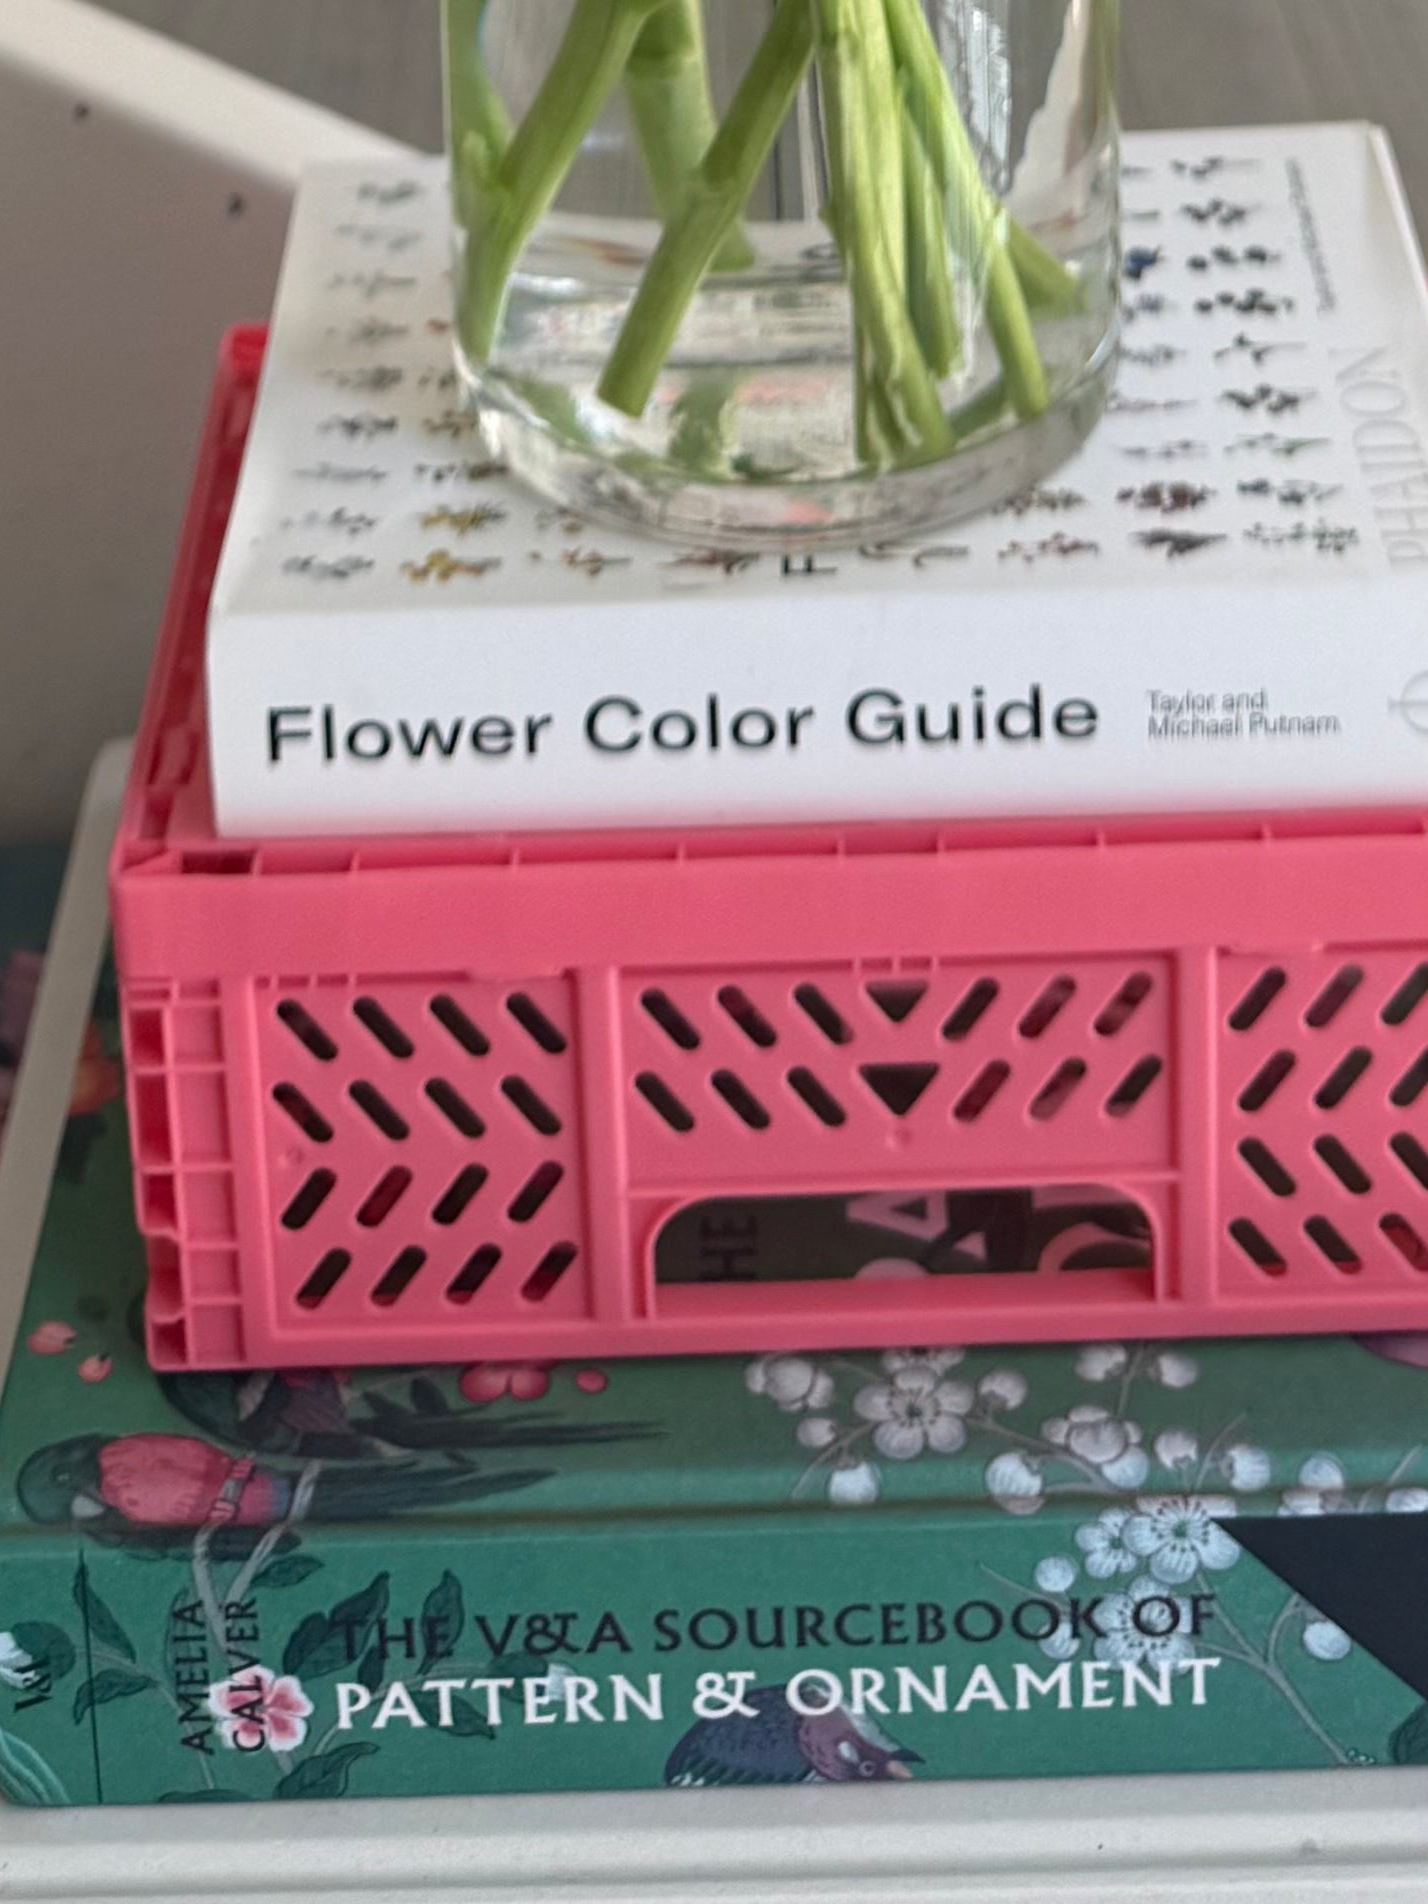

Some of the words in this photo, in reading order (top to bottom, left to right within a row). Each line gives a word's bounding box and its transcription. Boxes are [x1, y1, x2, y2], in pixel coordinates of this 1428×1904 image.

[266, 703, 553, 763] Flower
[583, 692, 816, 753] Color
[845, 683, 1100, 745] Guide
[1146, 690, 1215, 714] Taylor
[1221, 688, 1269, 711] and
[1147, 713, 1243, 737] Michael
[1249, 711, 1341, 735] Putnam
[336, 1614, 454, 1663] THE
[476, 1609, 629, 1658] V&A
[655, 1596, 1106, 1654] SOURCEBOOK
[1131, 1594, 1216, 1639] OF
[177, 1598, 213, 1755] AMELIA
[224, 1597, 267, 1753] CALVER
[336, 1672, 663, 1730] PATTERN
[693, 1670, 759, 1719] &
[786, 1657, 1222, 1716] ORNAMENT
